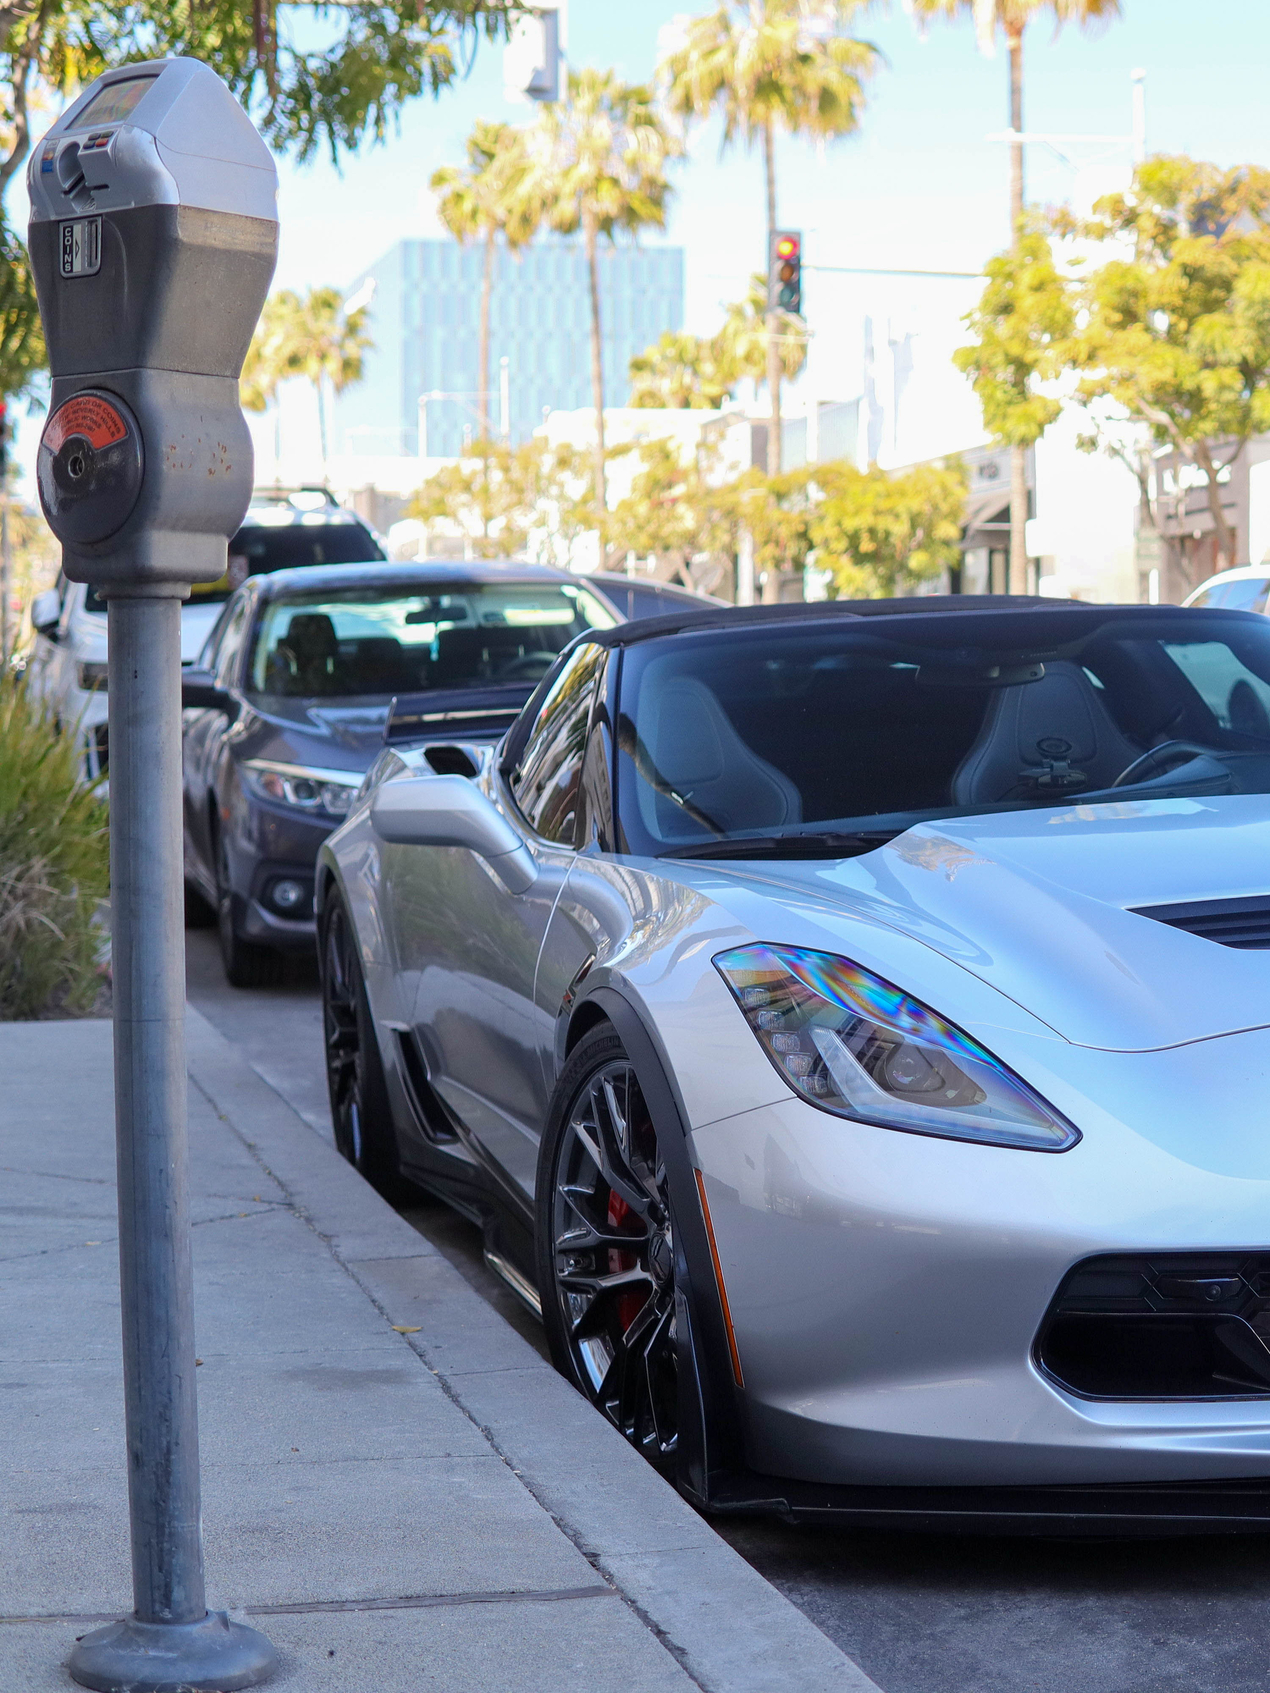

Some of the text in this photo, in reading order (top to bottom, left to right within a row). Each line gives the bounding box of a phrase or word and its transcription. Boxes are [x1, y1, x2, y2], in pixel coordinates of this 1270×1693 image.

[64, 227, 72, 272] COINS
[100, 415, 116, 438] HILLS
[103, 407, 121, 435] COINS
